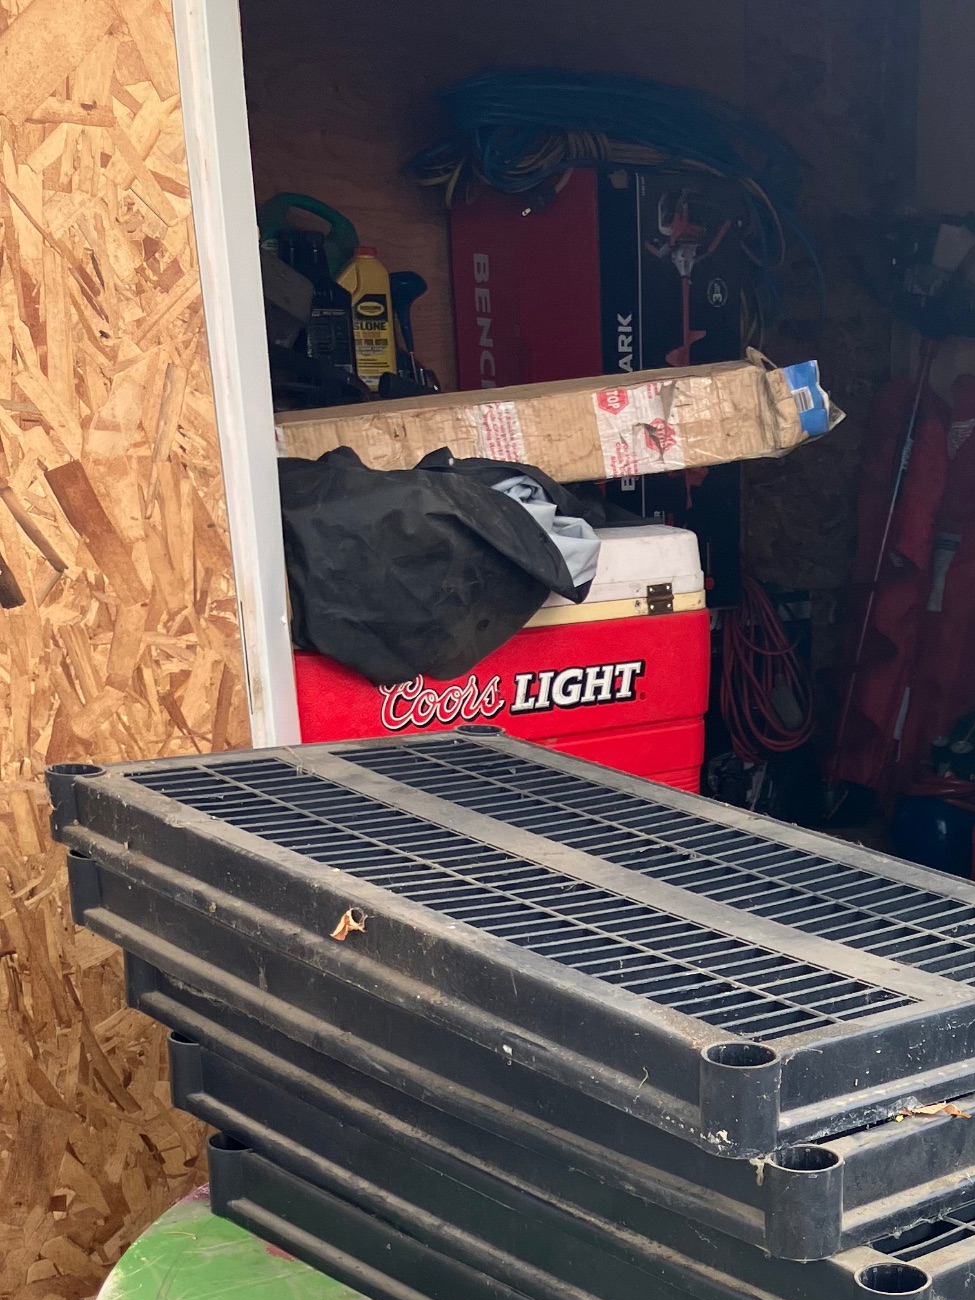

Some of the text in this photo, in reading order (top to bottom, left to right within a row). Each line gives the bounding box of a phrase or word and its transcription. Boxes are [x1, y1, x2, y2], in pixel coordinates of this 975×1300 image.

[473, 252, 496, 388] BENC
[606, 390, 620, 410] TOP
[379, 660, 642, 730] Coors LIGHT
